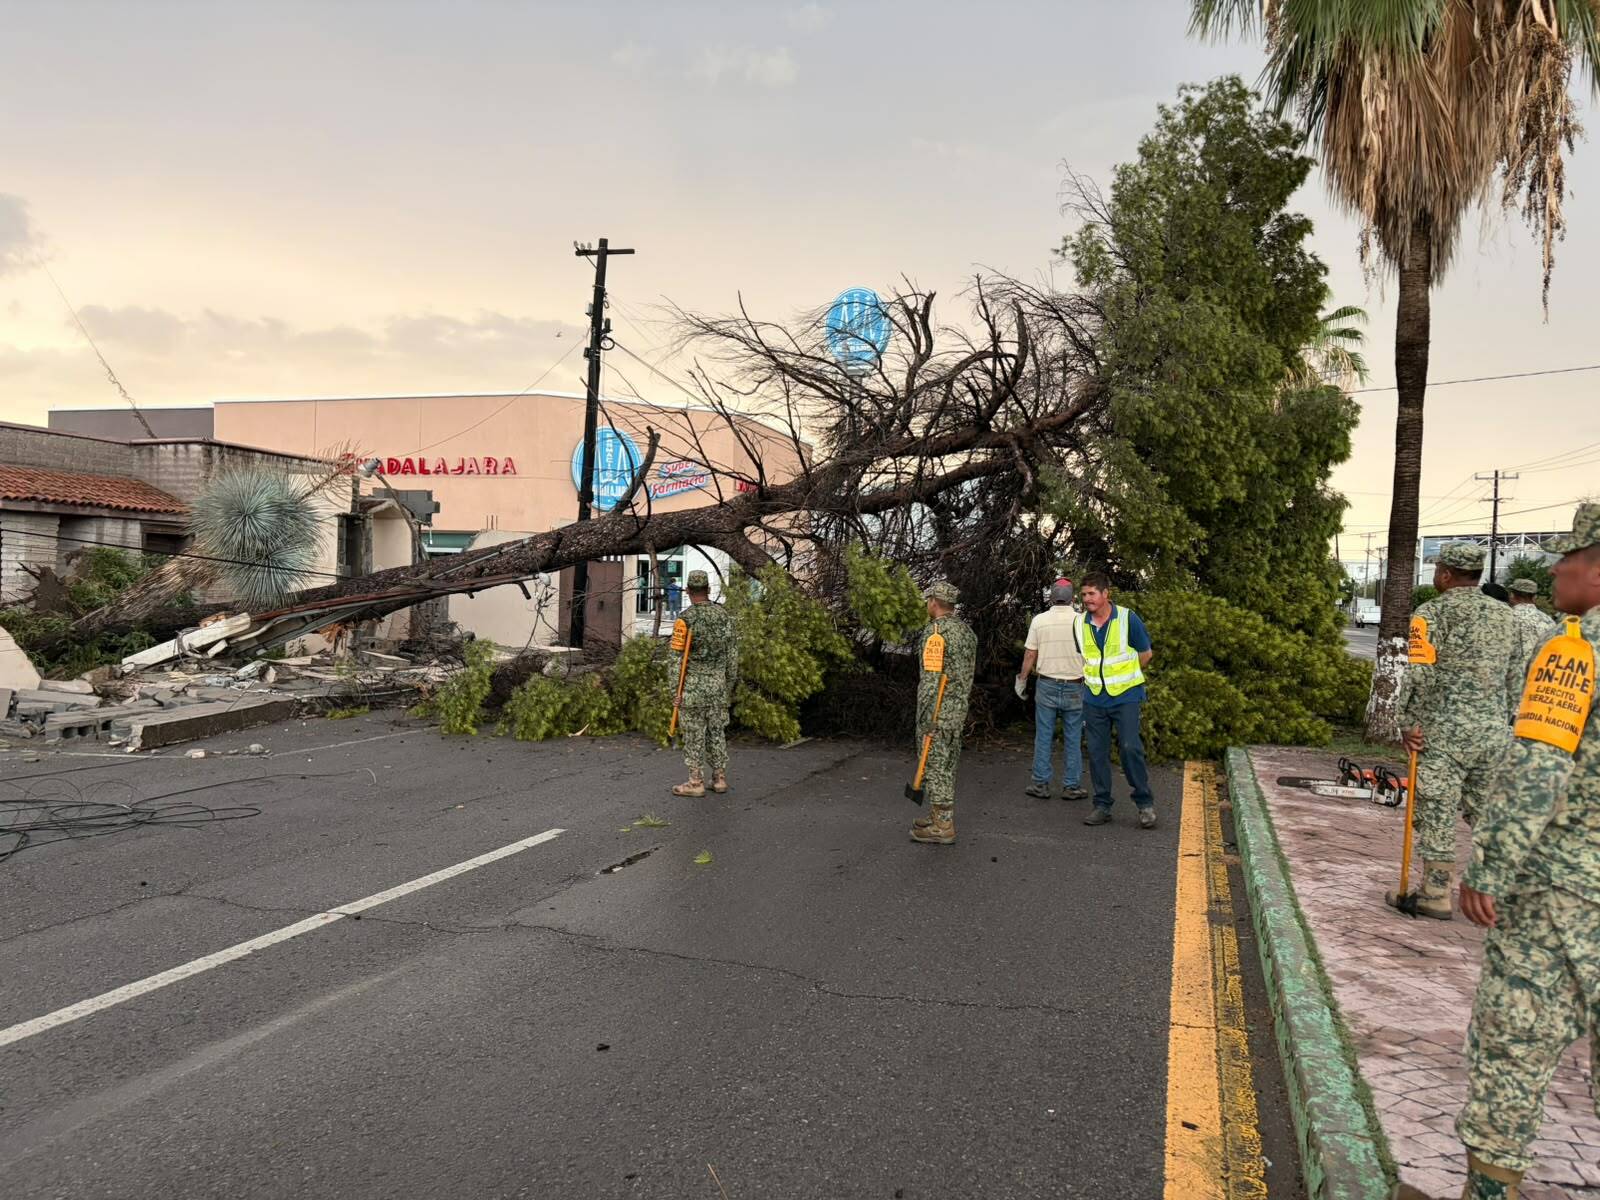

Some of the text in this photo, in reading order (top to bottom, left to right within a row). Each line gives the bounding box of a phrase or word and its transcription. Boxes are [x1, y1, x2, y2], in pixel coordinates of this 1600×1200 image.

[336, 453, 517, 476] GADALAJARA
[1545, 654, 1589, 677] PLAN
[1534, 667, 1591, 695] DN-III-E
[1547, 706, 1553, 715] Y
